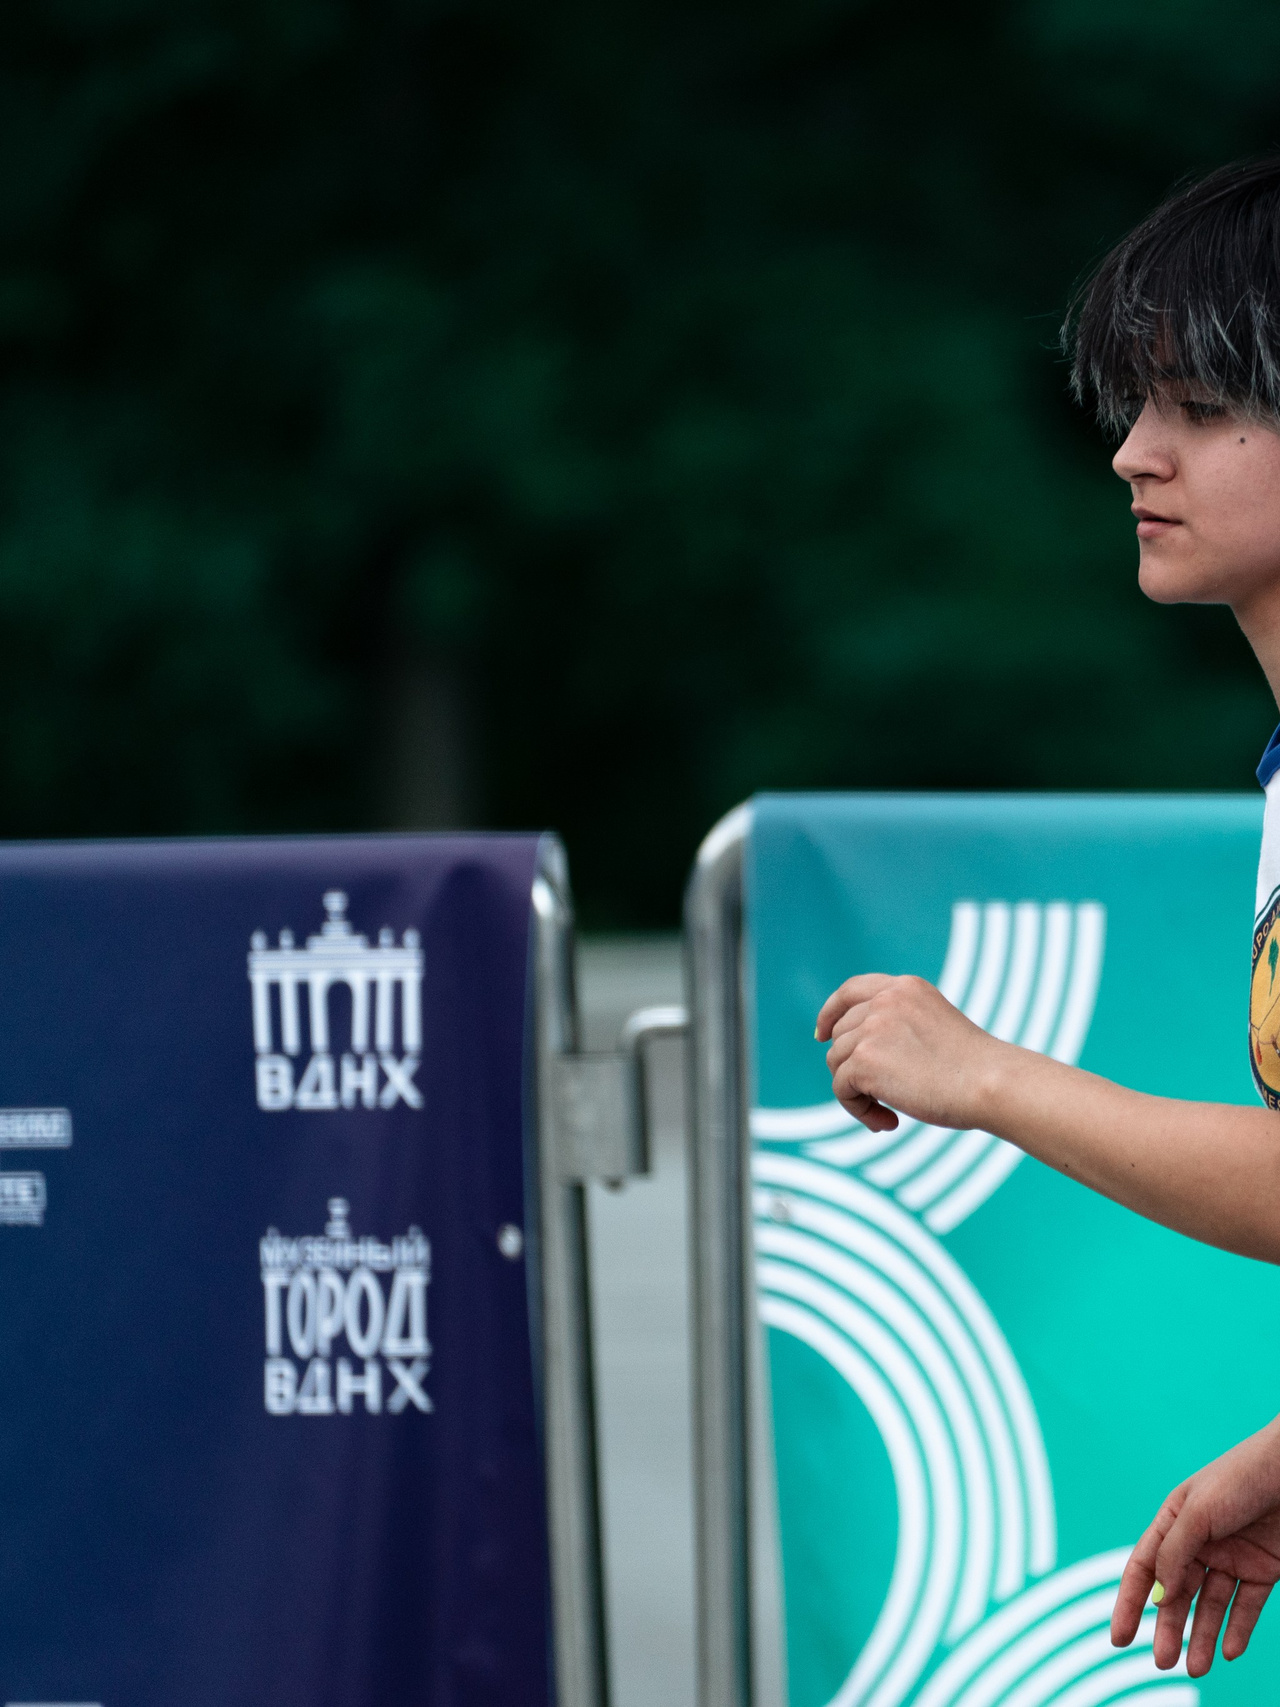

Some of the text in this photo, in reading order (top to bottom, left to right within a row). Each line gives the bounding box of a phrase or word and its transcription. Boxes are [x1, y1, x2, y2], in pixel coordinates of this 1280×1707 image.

[256, 1054, 423, 1110] ВДНХ
[261, 1266, 432, 1358] ГОРОД
[264, 1356, 434, 1416] ВДНХ
